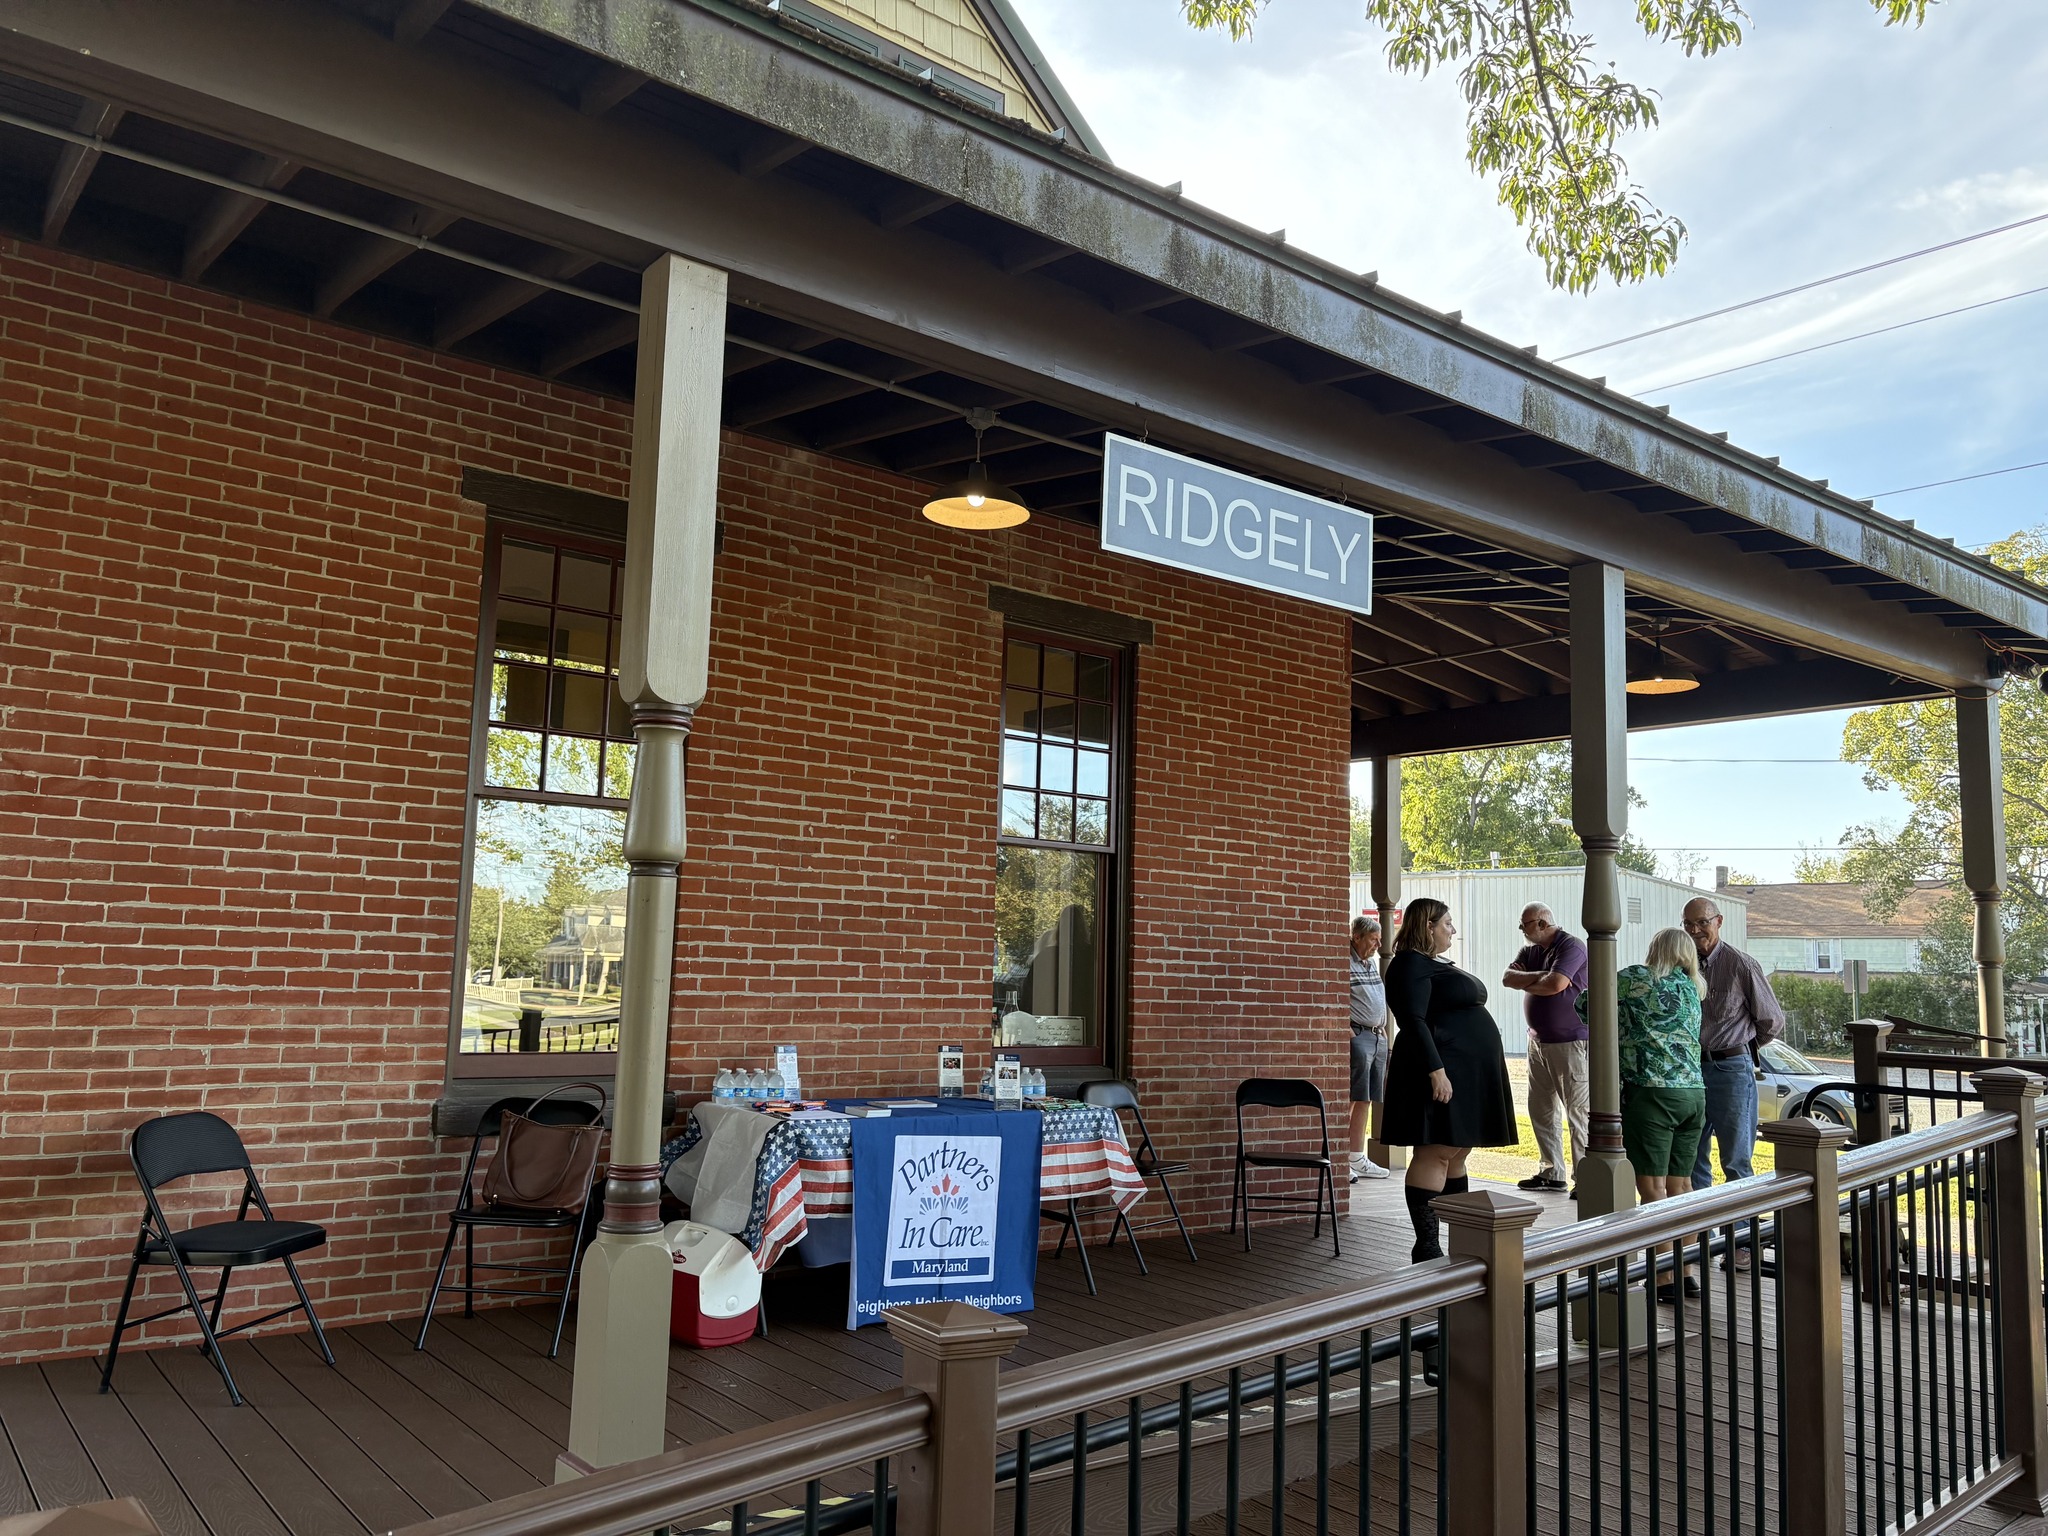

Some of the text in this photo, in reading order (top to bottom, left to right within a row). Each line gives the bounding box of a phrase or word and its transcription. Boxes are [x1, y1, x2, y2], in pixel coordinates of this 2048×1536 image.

[1117, 463, 1362, 586] RIDGELY
[898, 1141, 995, 1195] Partners
[898, 1217, 926, 1249] In
[929, 1216, 983, 1248] Care
[911, 1259, 969, 1277] Maryland
[855, 1299, 912, 1316] eighbors
[965, 1293, 1022, 1310] Neighbors
